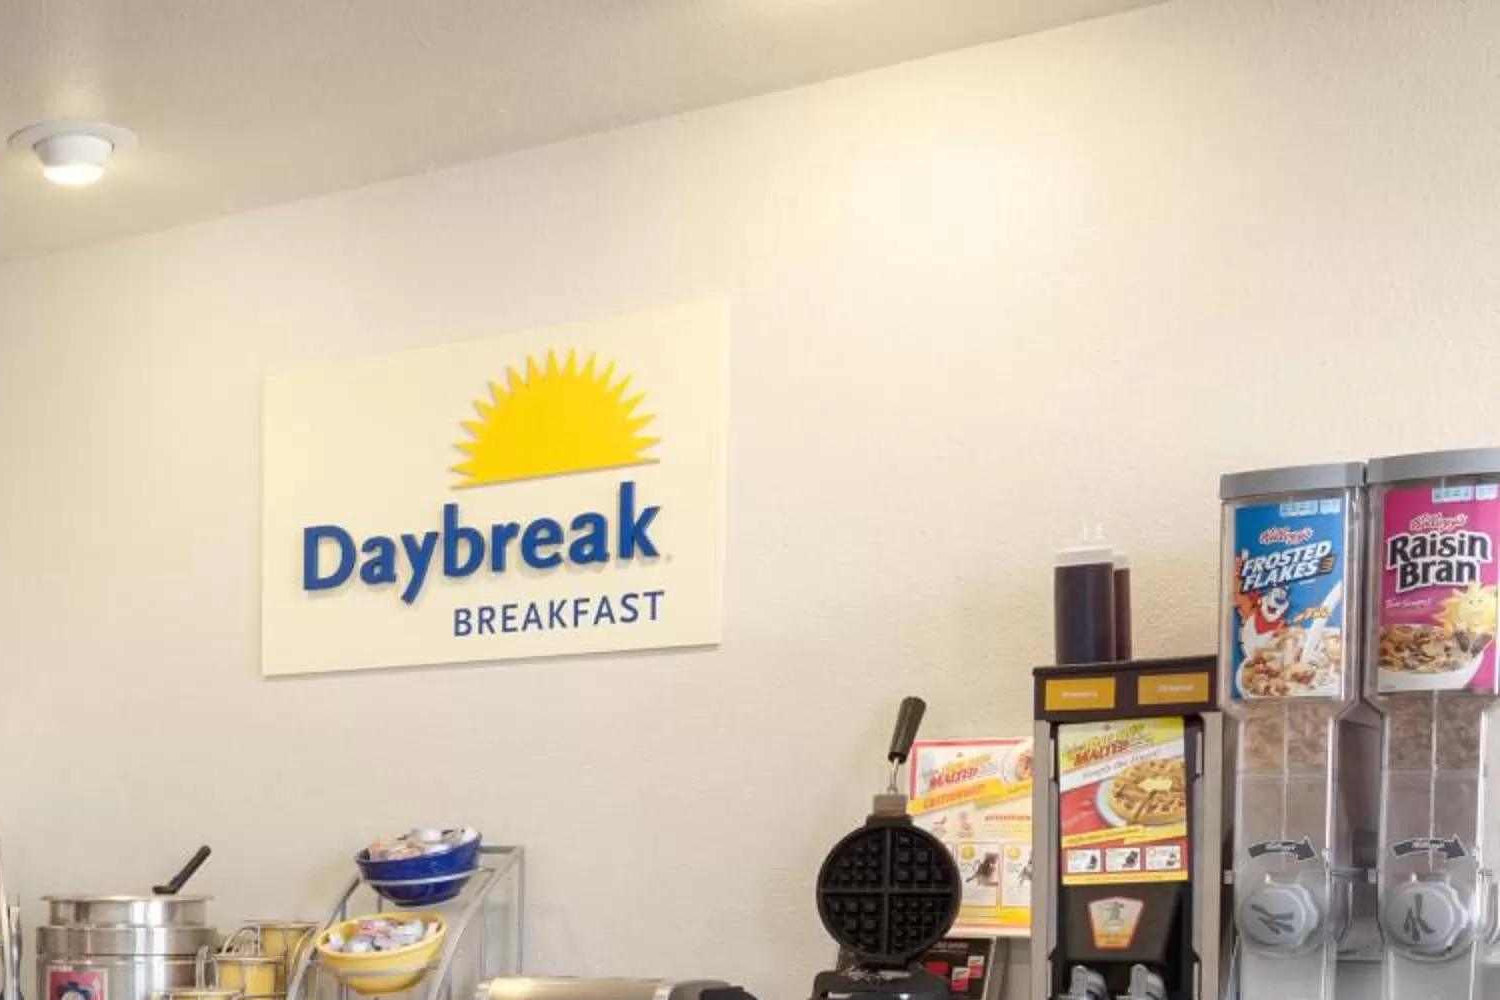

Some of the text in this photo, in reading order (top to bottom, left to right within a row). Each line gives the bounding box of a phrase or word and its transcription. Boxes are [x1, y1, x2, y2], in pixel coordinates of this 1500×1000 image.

[303, 481, 662, 605] Daybreak
[1242, 541, 1332, 577] FROSTED
[1387, 531, 1492, 569] Raisin
[1243, 559, 1319, 592] FLAKES
[1397, 560, 1477, 591] Bran
[453, 590, 665, 637] BREAKFAST
